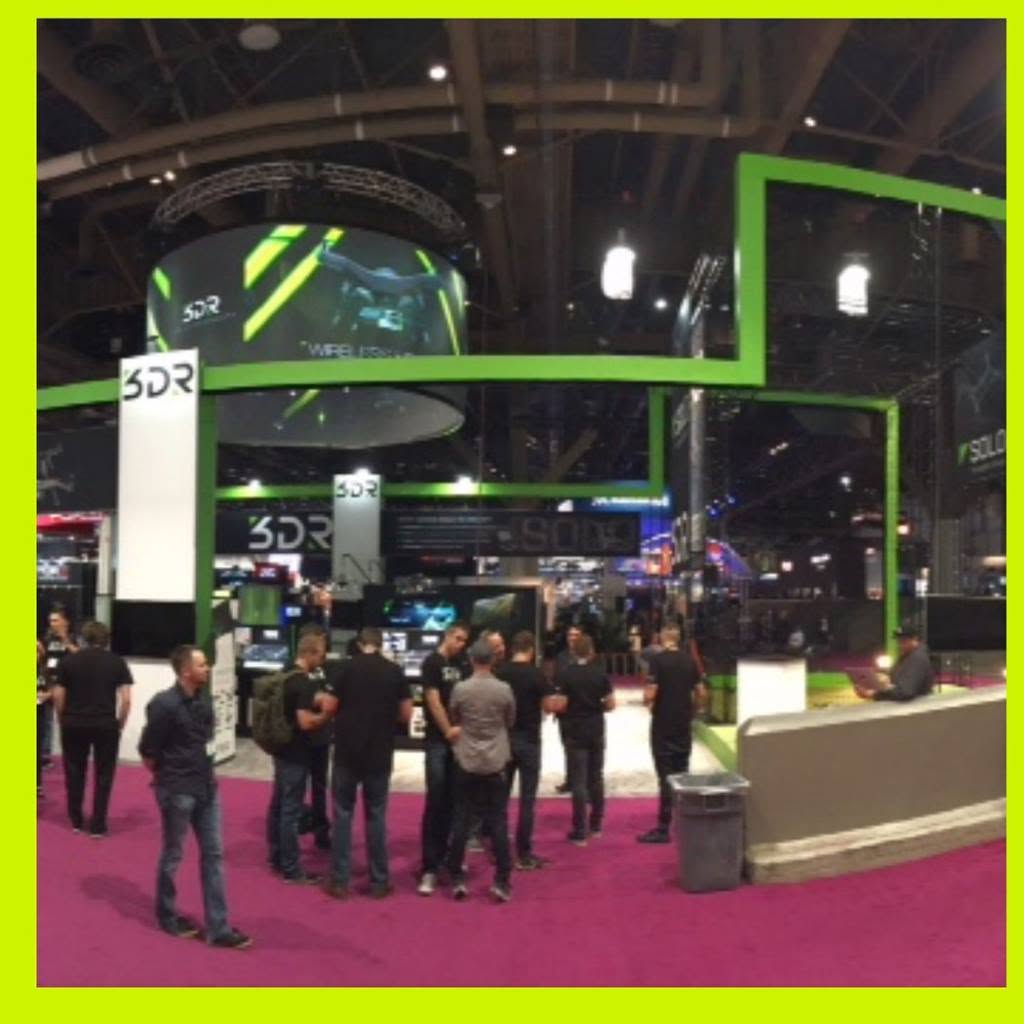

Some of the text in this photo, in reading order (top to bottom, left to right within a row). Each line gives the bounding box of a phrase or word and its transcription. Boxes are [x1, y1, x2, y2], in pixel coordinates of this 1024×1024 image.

[183, 295, 221, 323] 3DR
[123, 363, 194, 401] 3DR
[336, 480, 378, 498] 3DR
[248, 515, 334, 550] 3DR
